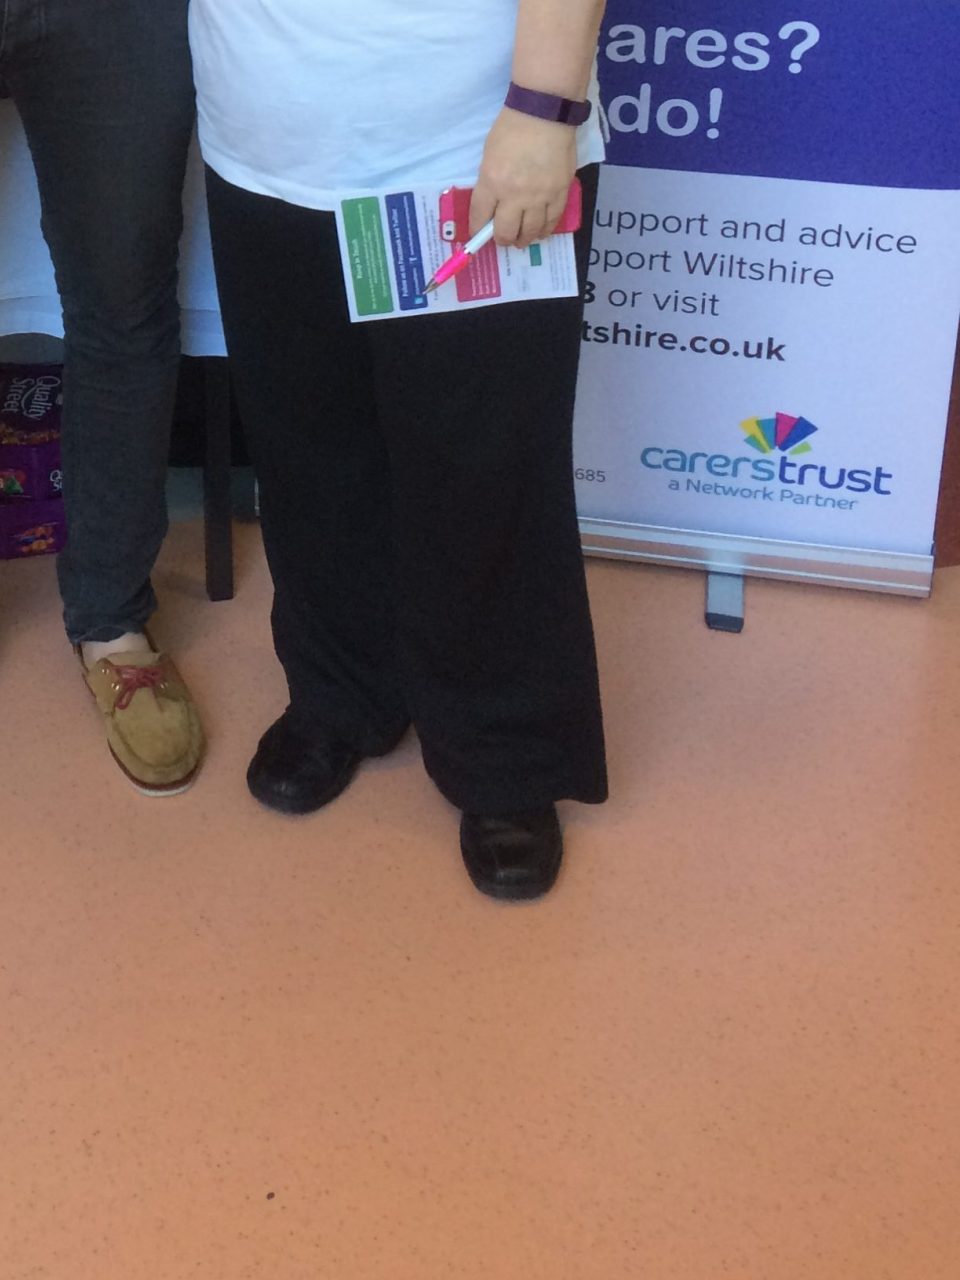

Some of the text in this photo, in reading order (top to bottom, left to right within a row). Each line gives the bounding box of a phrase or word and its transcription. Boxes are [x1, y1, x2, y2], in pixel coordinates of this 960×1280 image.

[605, 20, 820, 74] ares?
[607, 82, 724, 140] do!
[595, 208, 917, 254] upport and advice
[684, 249, 834, 287] Wiltshire
[608, 288, 642, 308] or
[653, 290, 720, 316] visit
[581, 320, 786, 362] tshire.co.uk
[1, 377, 35, 414] Street
[23, 375, 61, 421] Quality
[668, 478, 859, 511] a Network Partner
